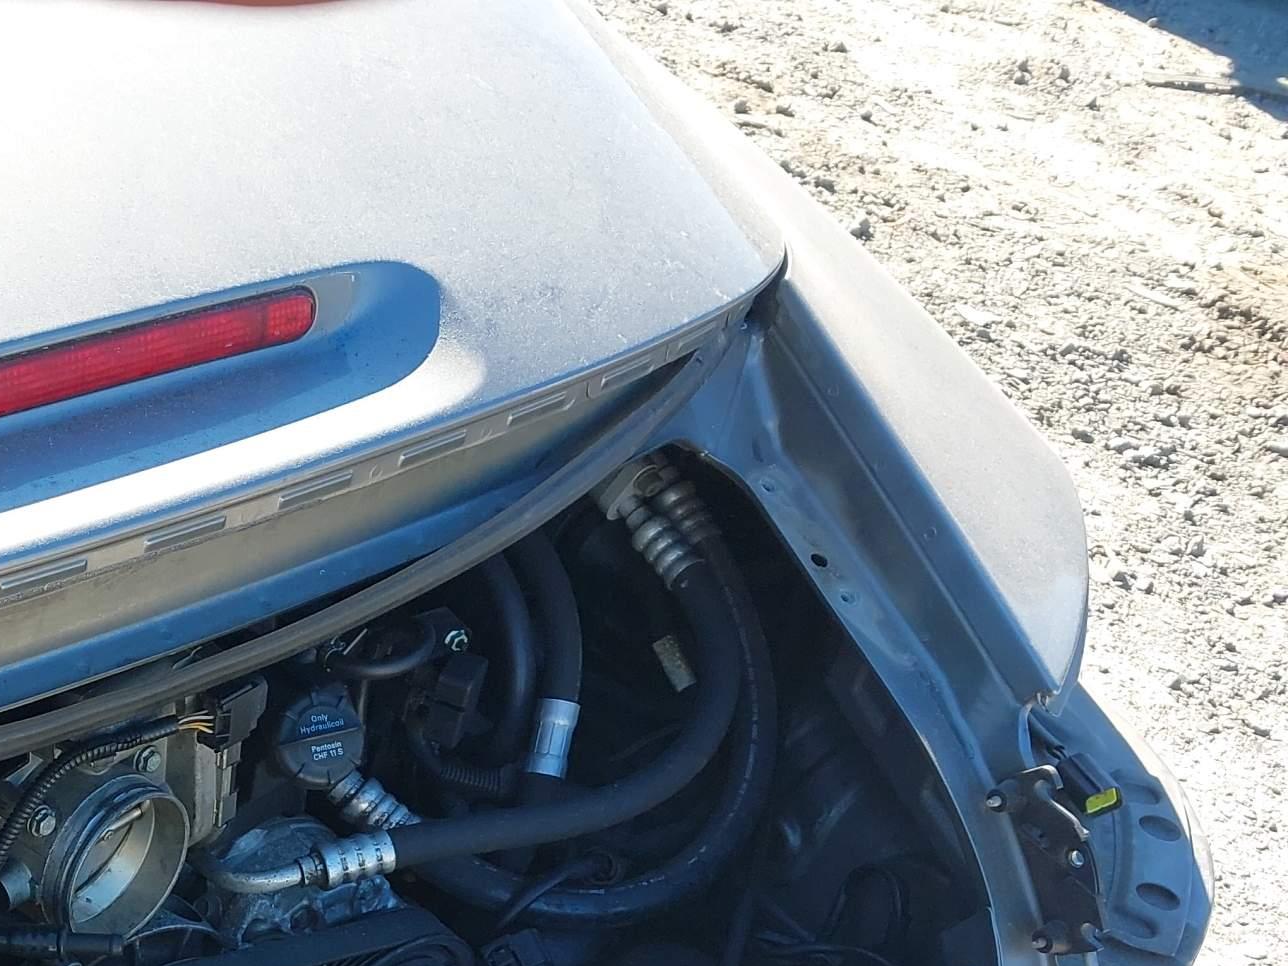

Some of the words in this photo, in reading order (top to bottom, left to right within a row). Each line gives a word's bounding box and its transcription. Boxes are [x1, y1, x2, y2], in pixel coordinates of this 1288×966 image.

[311, 714, 328, 723] Only
[311, 740, 342, 753] Pentosin
[313, 751, 328, 761] CHF
